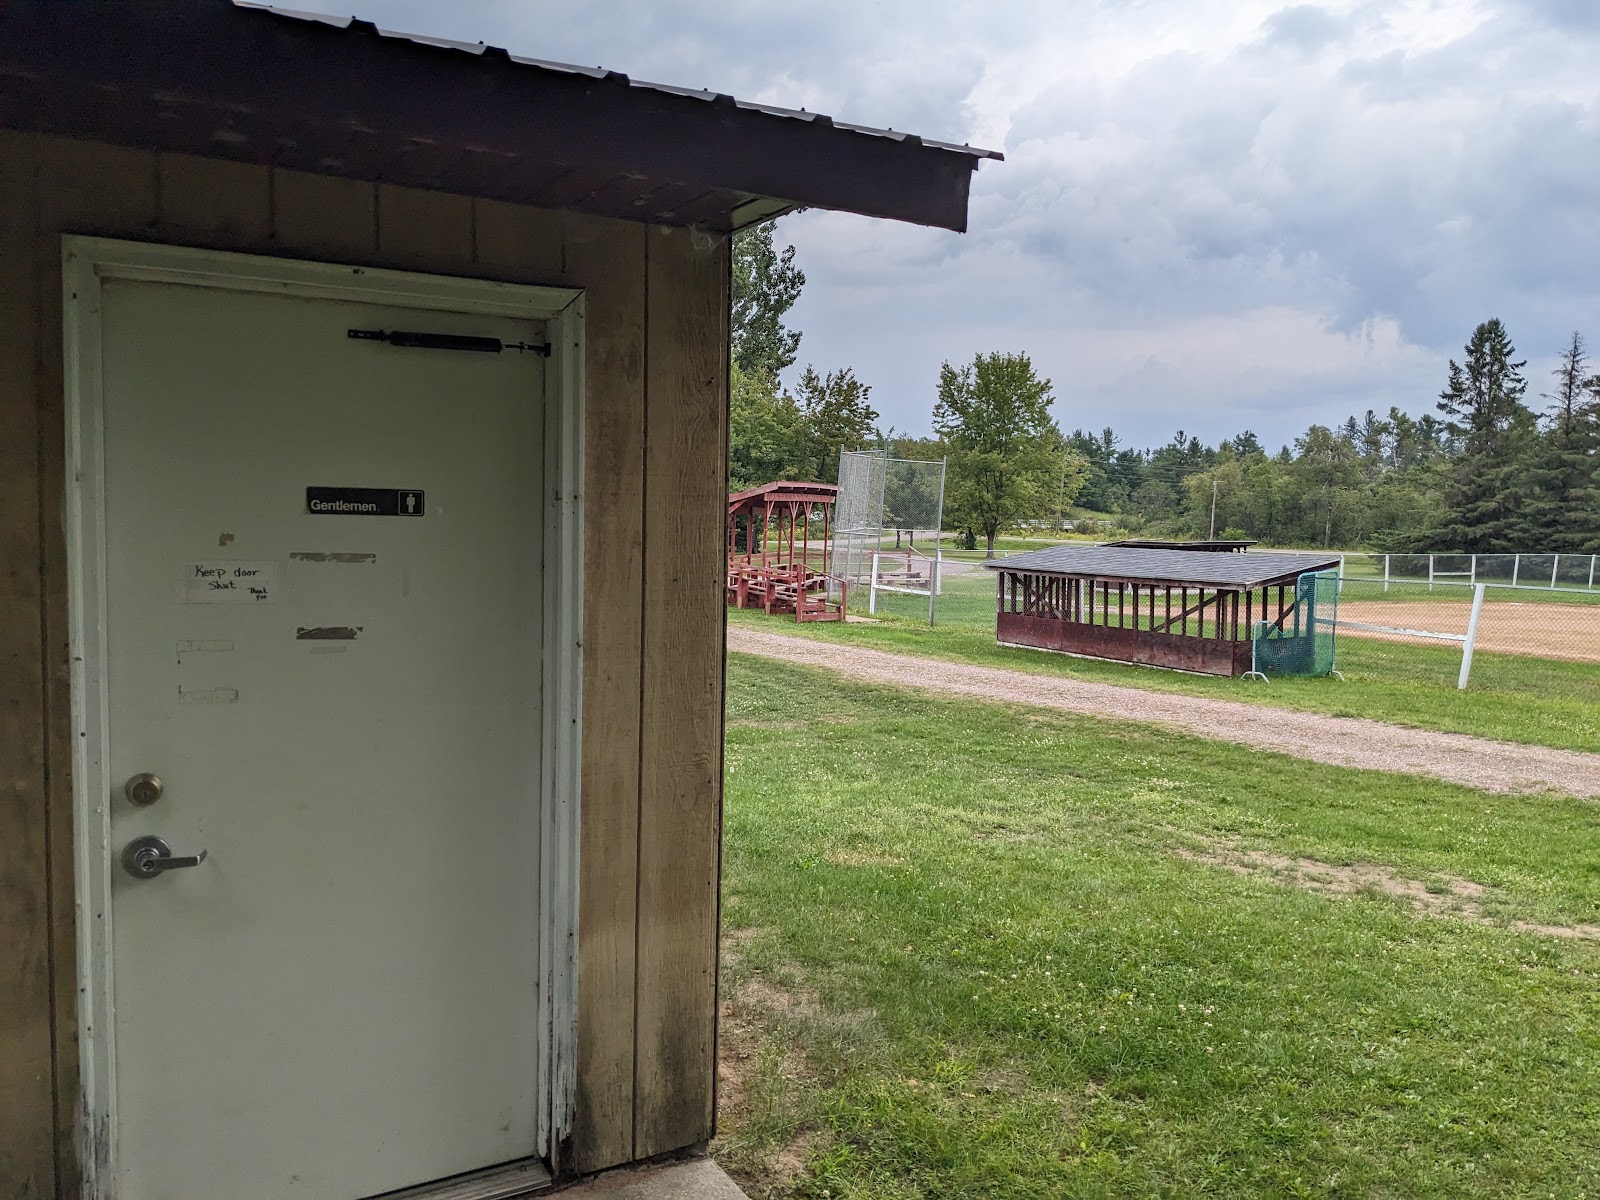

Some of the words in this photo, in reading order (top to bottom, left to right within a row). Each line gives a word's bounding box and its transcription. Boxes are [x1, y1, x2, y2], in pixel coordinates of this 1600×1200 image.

[310, 499, 377, 512] Gentlemen
[195, 565, 227, 579] Keep
[233, 567, 261, 578] door
